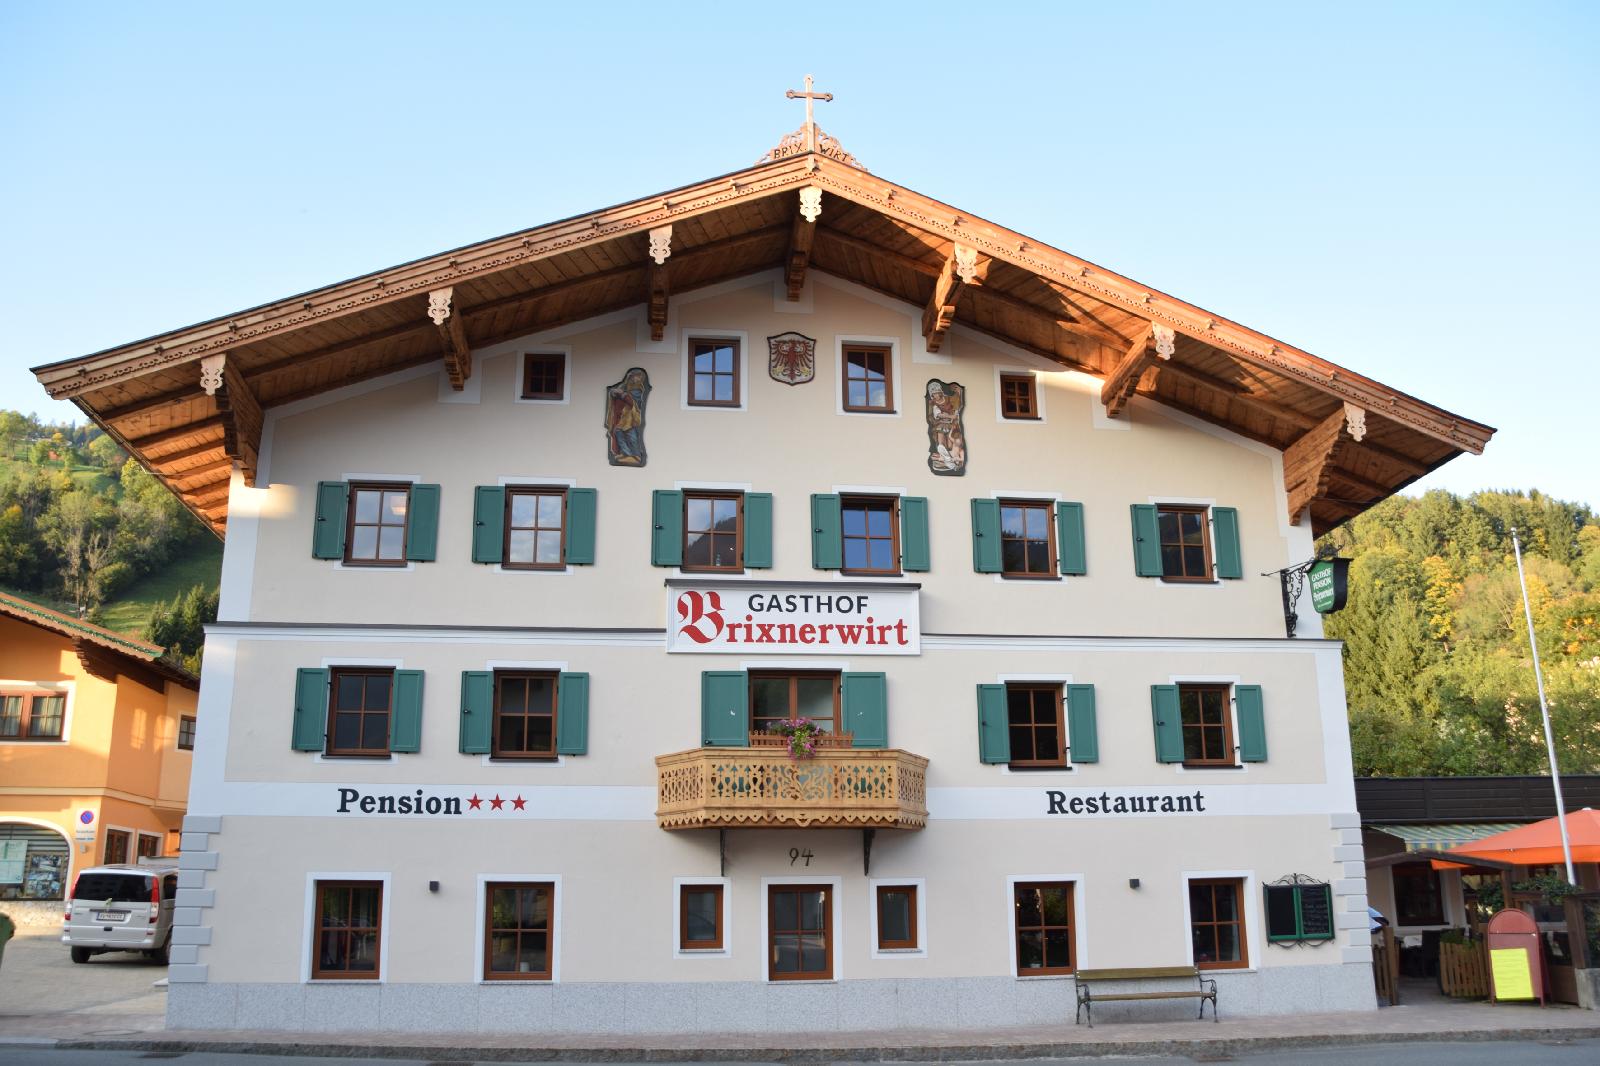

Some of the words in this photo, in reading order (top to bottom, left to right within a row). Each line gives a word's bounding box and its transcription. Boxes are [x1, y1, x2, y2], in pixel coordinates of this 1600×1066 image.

[819, 143, 849, 162] WIRT
[747, 593, 869, 615] GASTHOF
[676, 590, 909, 645] Brixnerwirt
[336, 788, 462, 815] Pension
[1046, 790, 1206, 815] Restaurant
[789, 847, 814, 867] 94
